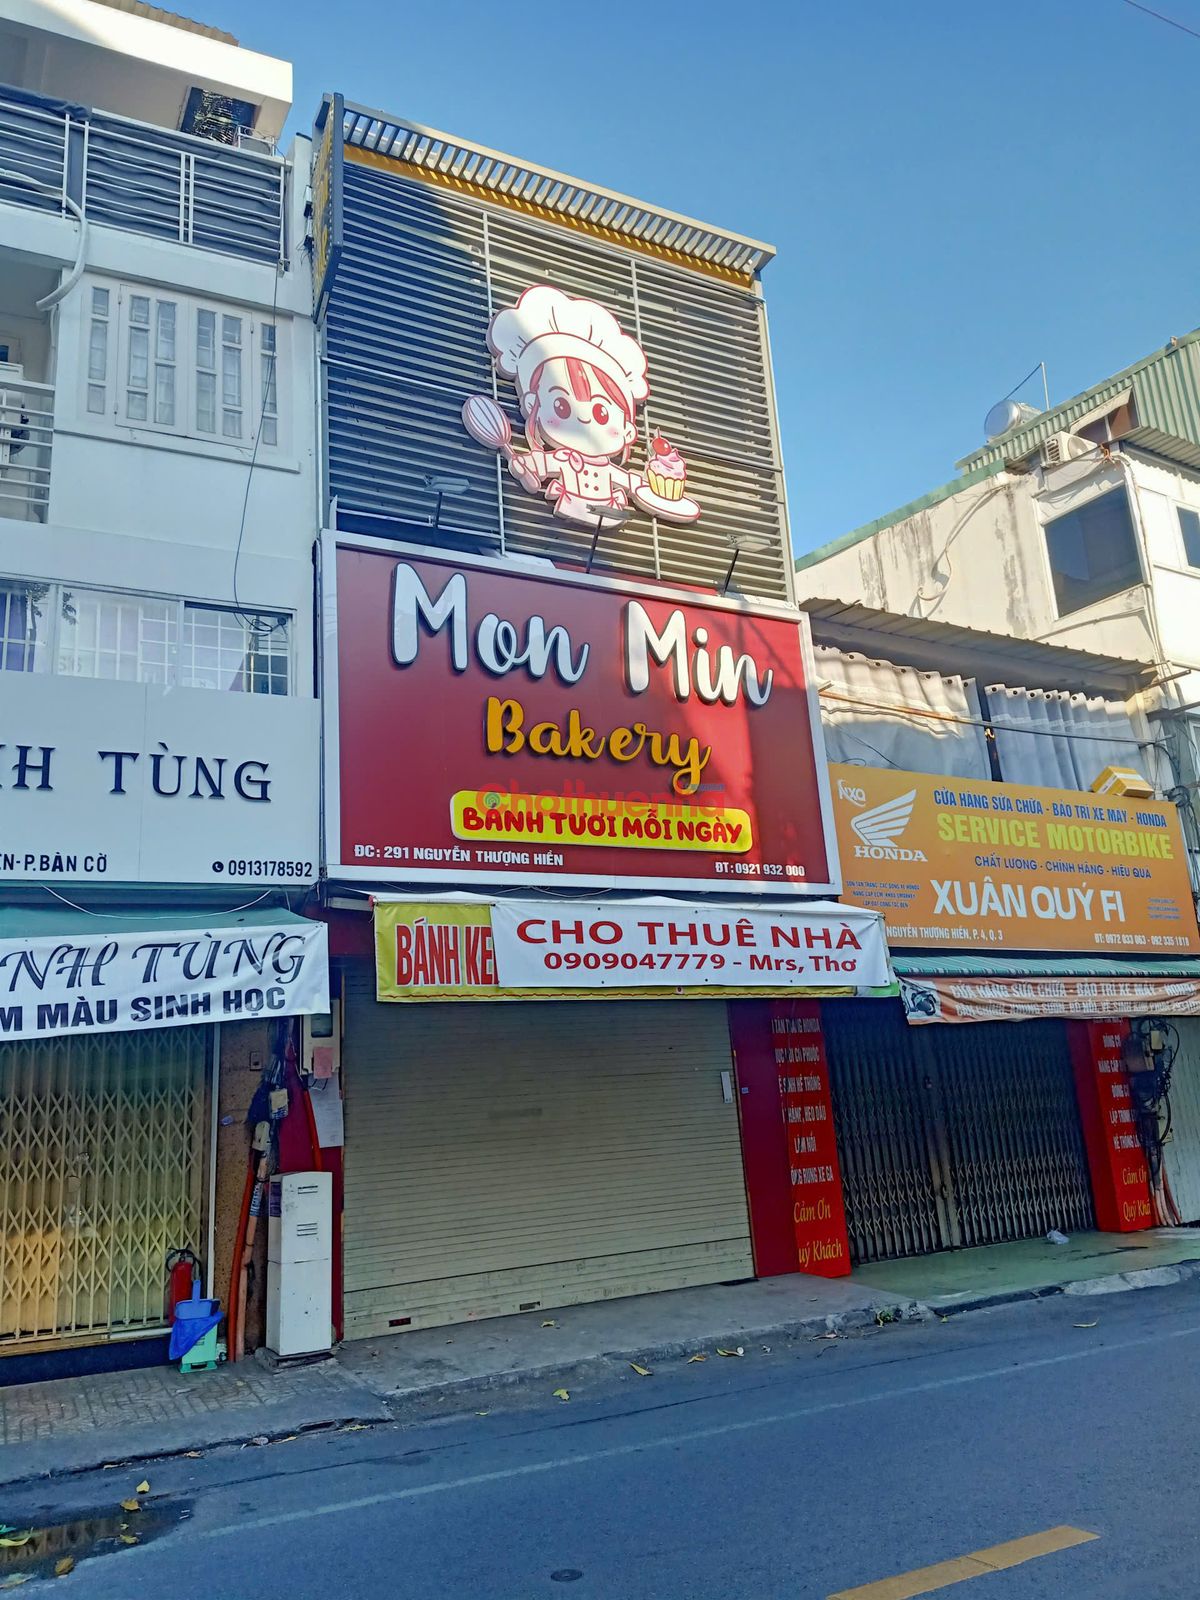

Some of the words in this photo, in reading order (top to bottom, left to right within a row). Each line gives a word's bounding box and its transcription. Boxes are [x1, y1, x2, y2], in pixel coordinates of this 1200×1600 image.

[393, 562, 590, 685] Mon
[624, 600, 774, 707] Min
[486, 696, 712, 796] Bakery
[0, 743, 56, 790] H
[98, 742, 273, 803] TÙNG
[550, 813, 617, 838] TƯƠI
[622, 809, 672, 840] MỖI
[677, 816, 743, 844] NGÀY
[1092, 808, 1105, 821] XE
[1136, 812, 1168, 828] HONDA
[937, 812, 1041, 849] SERVICE
[1046, 823, 1174, 860] MOTORBIKE
[84, 852, 107, 873] CỜ
[228, 860, 313, 878] 0913178592
[384, 846, 410, 859] 291
[413, 846, 471, 862] NGUYỄN
[475, 849, 530, 867] THƯỢNG
[533, 848, 564, 866] HIỀN
[853, 845, 928, 862] HONDA
[763, 865, 784, 876] 932
[785, 865, 805, 877] 000
[930, 876, 1028, 918] XUÂN
[1031, 882, 1095, 921] QUÝ
[1101, 889, 1126, 922] FI
[516, 919, 623, 945] CHO
[637, 917, 757, 947] THUÊ
[770, 922, 862, 950] NHÀ
[131, 932, 306, 984] TÙNG
[396, 917, 461, 985] BÁNH
[465, 925, 499, 985] KE
[544, 953, 726, 970] 0909047779
[749, 954, 804, 974] Mrs,
[808, 955, 857, 972] Thơ
[37, 996, 118, 1030] MÀU
[130, 992, 211, 1022] SINH
[223, 987, 286, 1016] HỌC
[794, 1200, 816, 1224] Cảm
[813, 1237, 843, 1262] Khách
